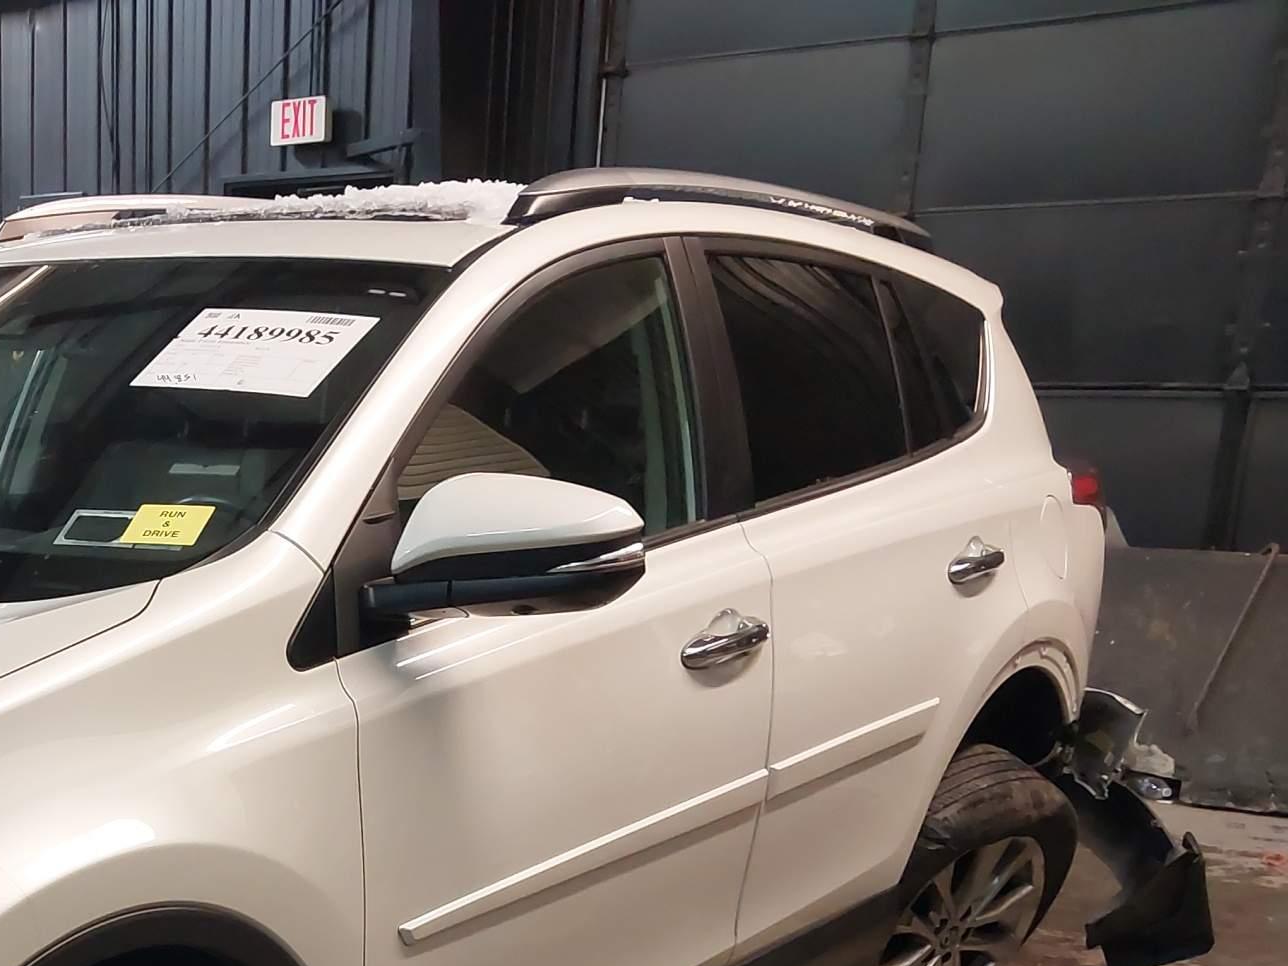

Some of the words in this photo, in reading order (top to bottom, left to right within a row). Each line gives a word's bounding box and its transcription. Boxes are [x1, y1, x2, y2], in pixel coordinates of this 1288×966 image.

[281, 99, 317, 139] EXIT
[198, 324, 341, 346] 44189985
[160, 510, 187, 518] RUN
[162, 520, 170, 528] &
[142, 529, 180, 538] DRIVE
